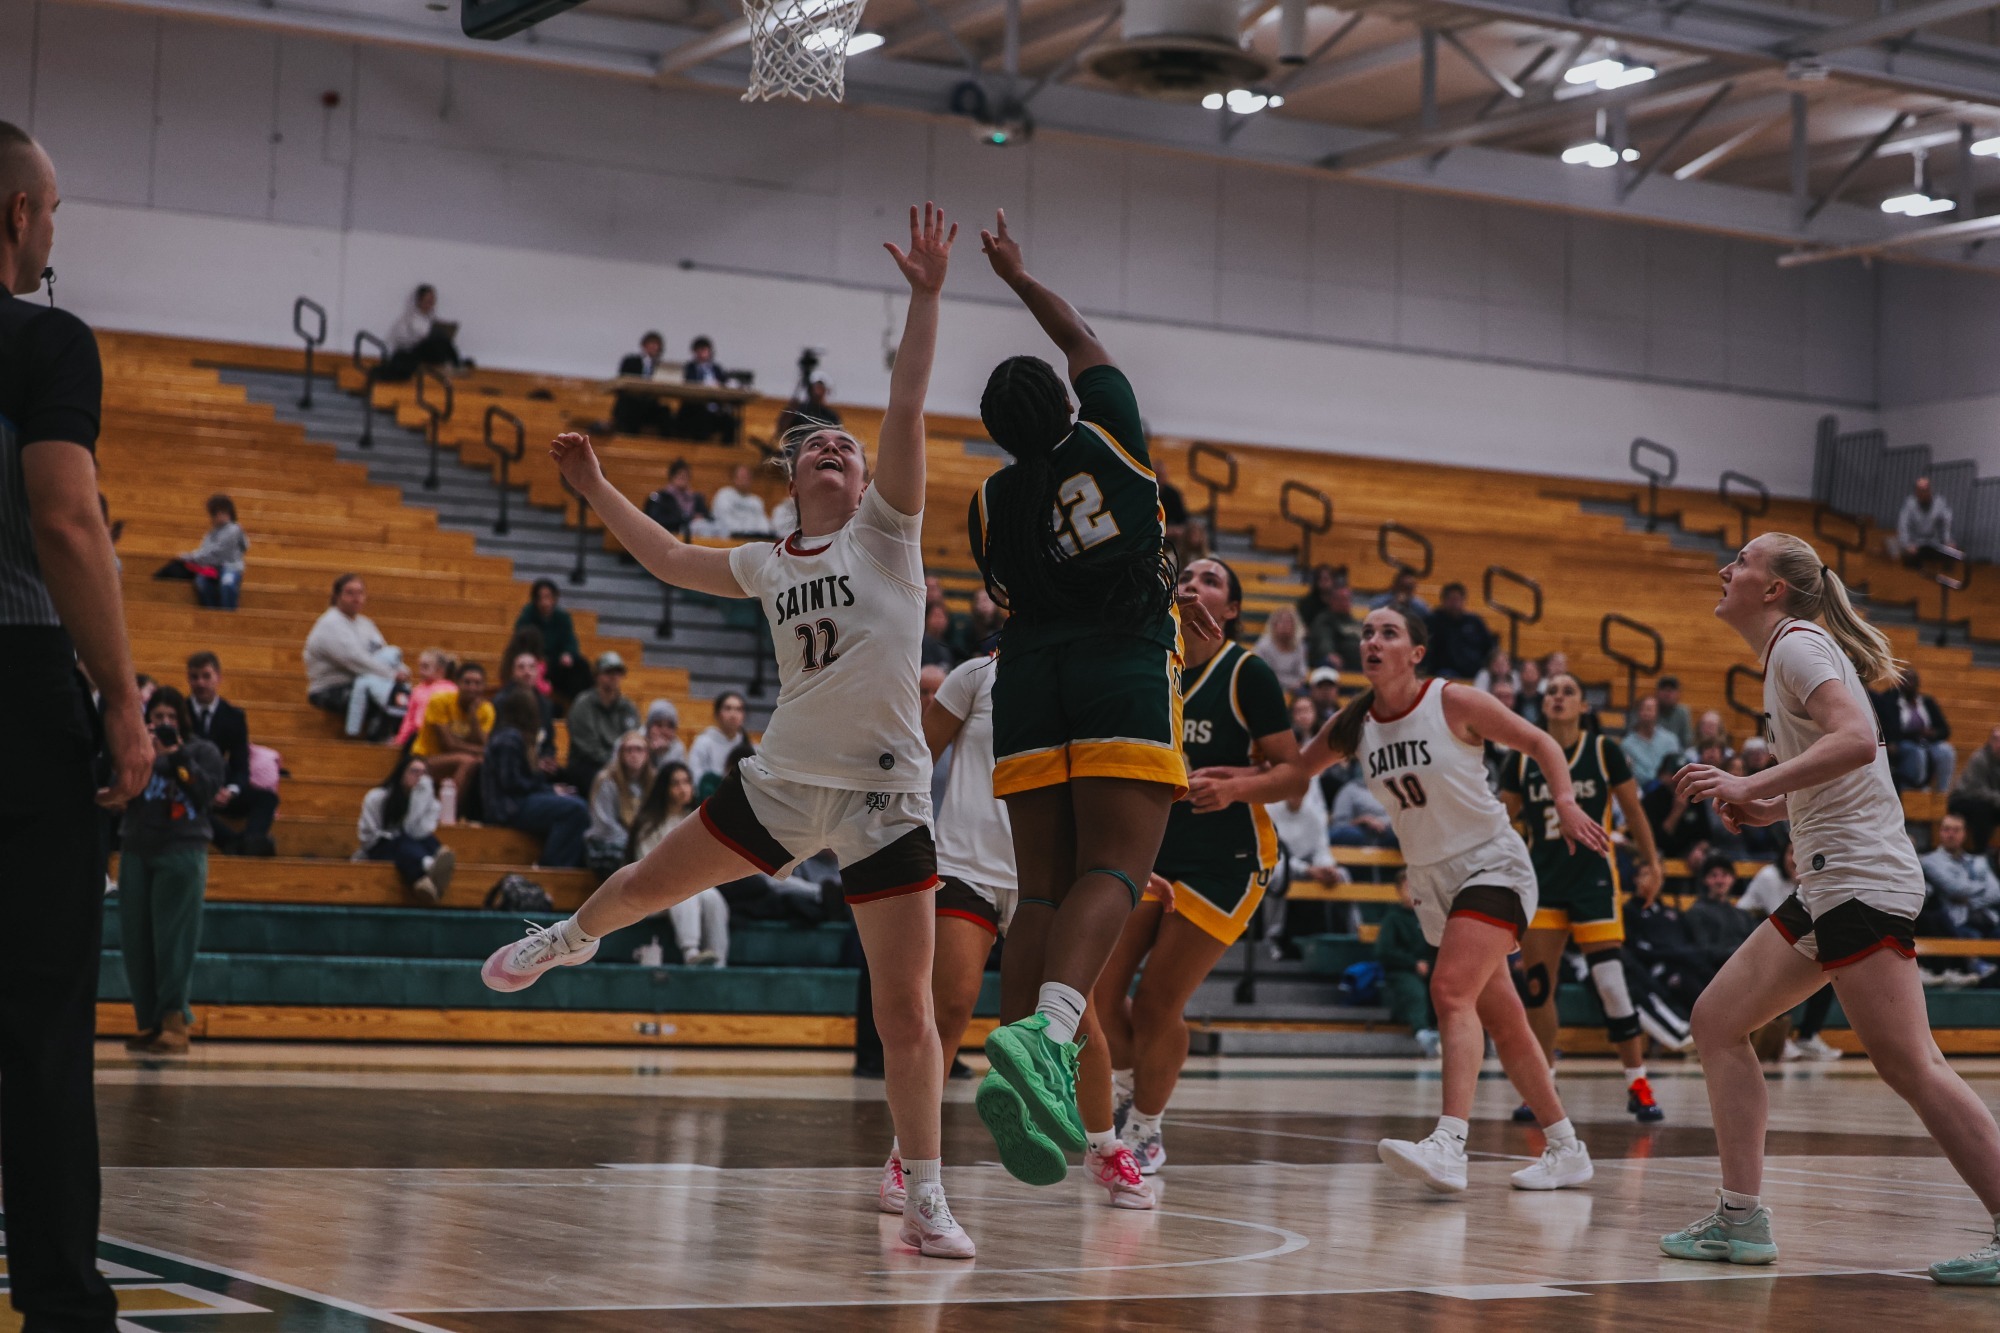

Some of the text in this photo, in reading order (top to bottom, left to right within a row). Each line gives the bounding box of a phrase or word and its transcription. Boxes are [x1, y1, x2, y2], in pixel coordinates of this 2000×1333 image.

[775, 575, 855, 626] SAINTS
[794, 617, 840, 672] 12
[1368, 740, 1432, 779] SAINTS
[1383, 772, 1427, 811] 10
[1528, 780, 1597, 803] LARS
